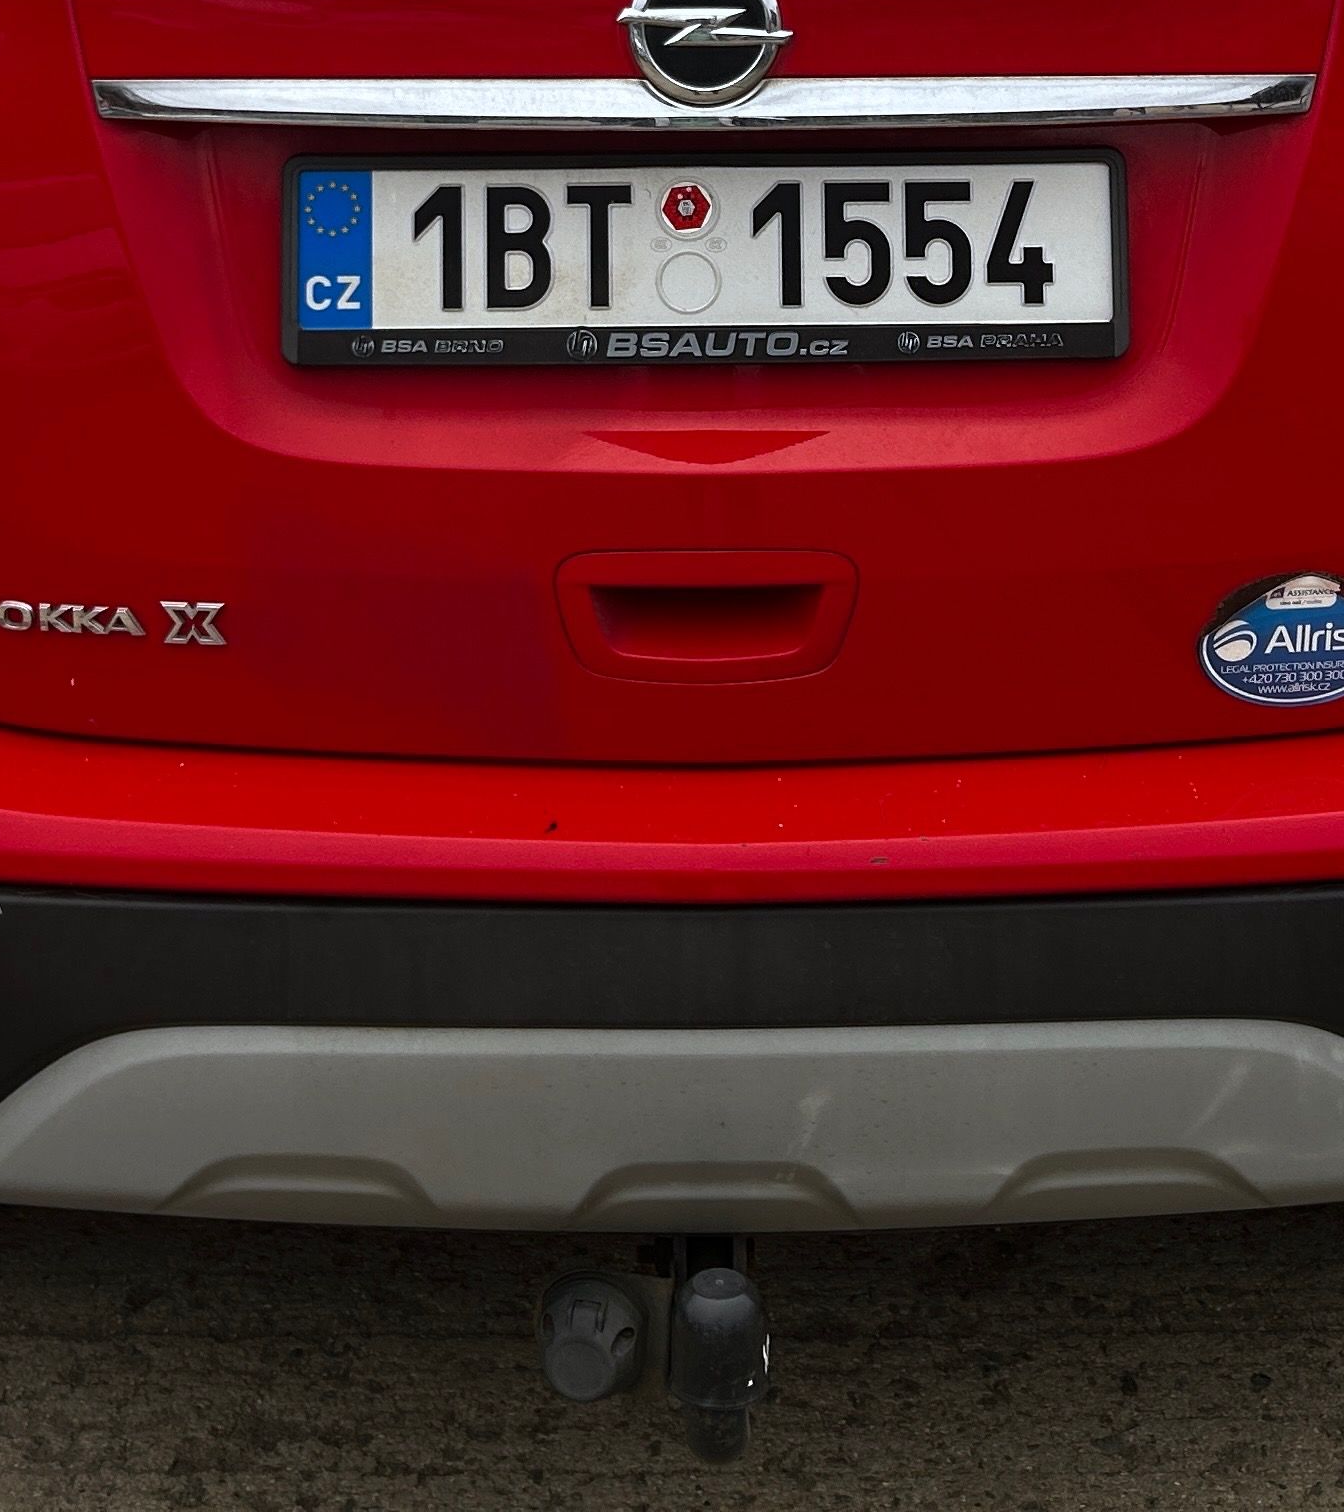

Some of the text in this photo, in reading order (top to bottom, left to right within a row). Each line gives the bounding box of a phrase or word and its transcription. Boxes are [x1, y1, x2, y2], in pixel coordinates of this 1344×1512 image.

[305, 179, 1055, 313] CZ 1BT 1554
[381, 339, 505, 353] BSA BRNO
[607, 332, 849, 358] BSAUTO.cz
[926, 333, 1064, 349] BSA PRAHA
[159, 600, 227, 645] X
[1221, 665, 1251, 674] LEGAL
[1253, 661, 1315, 672] PROTECTION
[1243, 674, 1273, 684] +420
[1274, 672, 1297, 683] 730
[1299, 671, 1323, 682] 300
[1258, 682, 1331, 694] www.allrisk.cz
